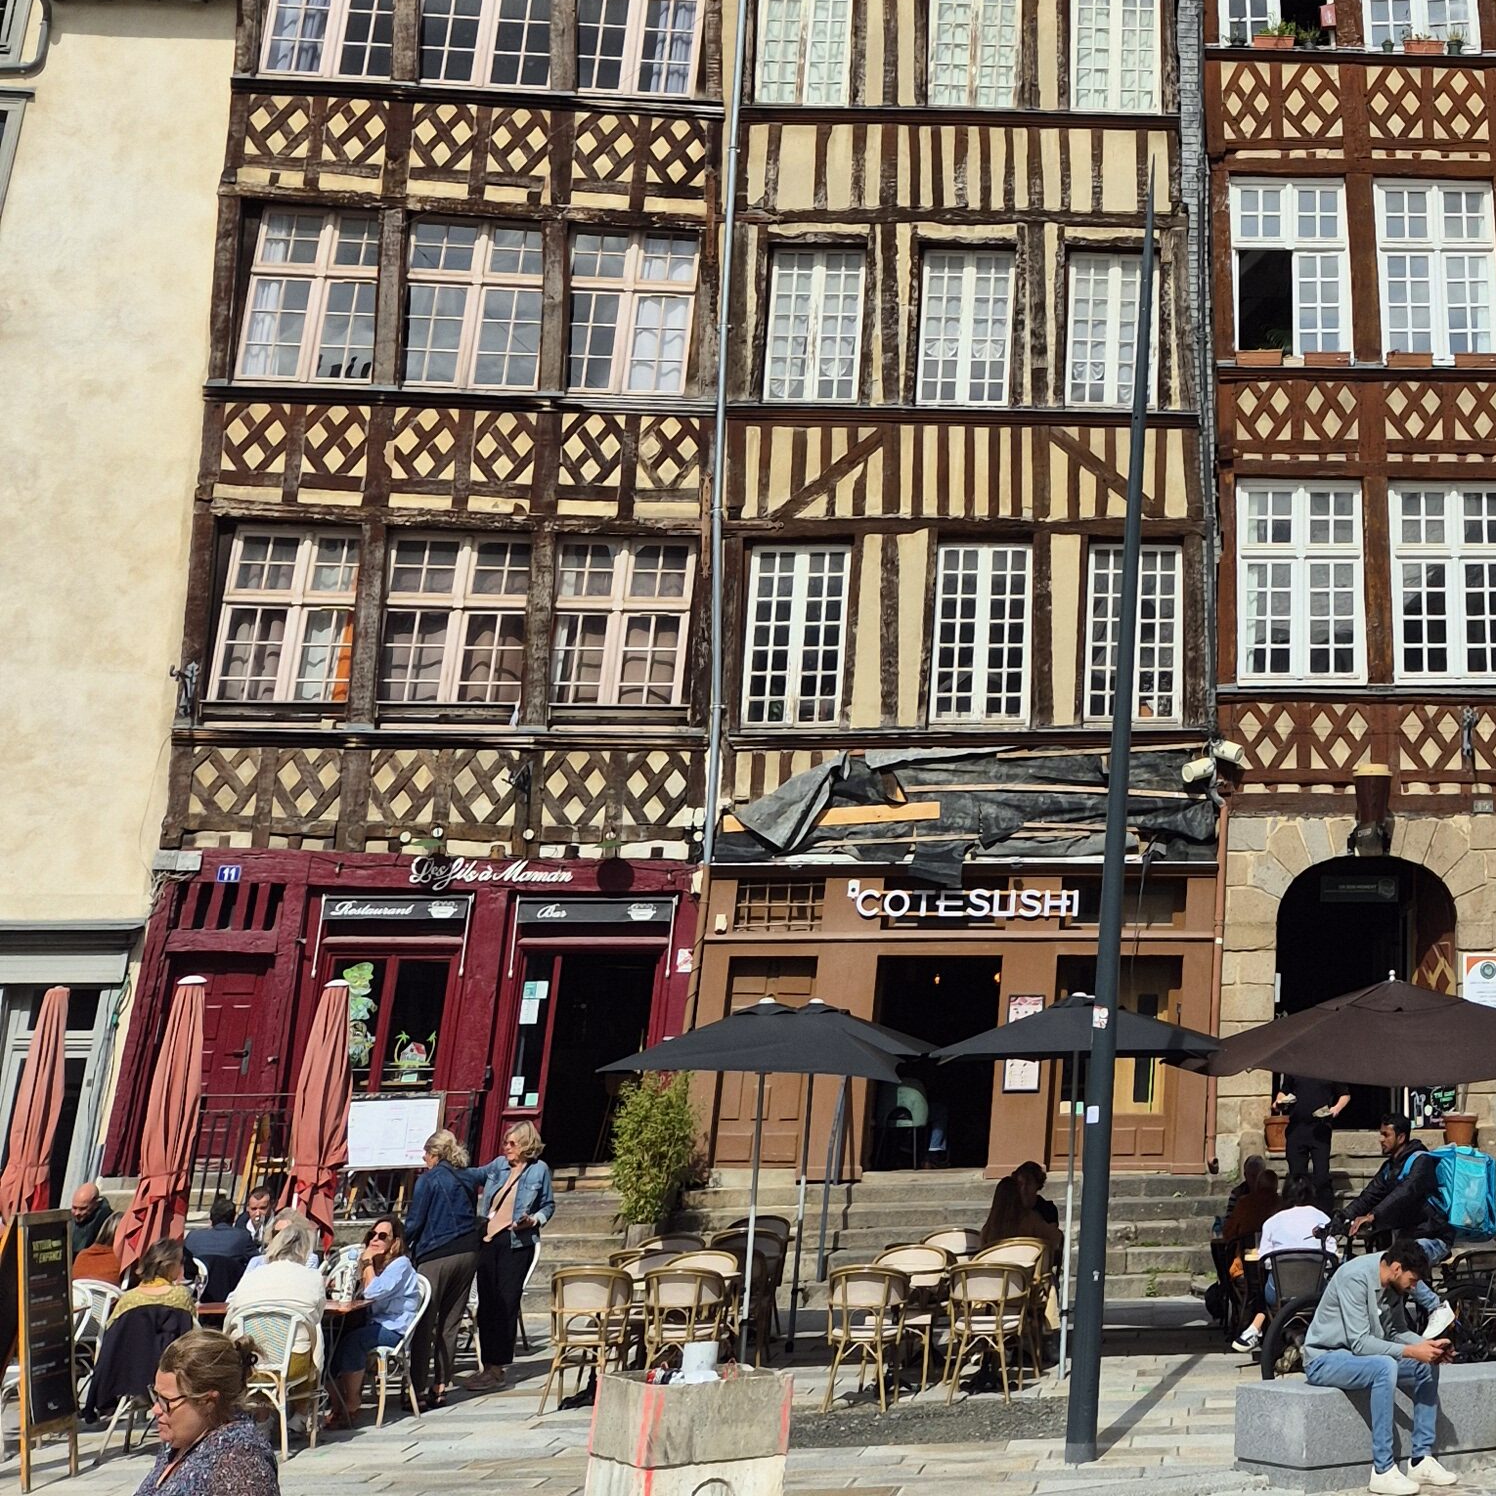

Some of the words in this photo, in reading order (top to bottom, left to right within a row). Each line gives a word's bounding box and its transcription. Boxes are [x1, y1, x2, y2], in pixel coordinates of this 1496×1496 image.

[222, 867, 236, 881] 11
[409, 856, 449, 884] Les
[432, 856, 478, 891] fils
[478, 865, 493, 882] à
[493, 859, 574, 883] Maman
[329, 900, 414, 917] Restaurant
[537, 903, 567, 919] Bar
